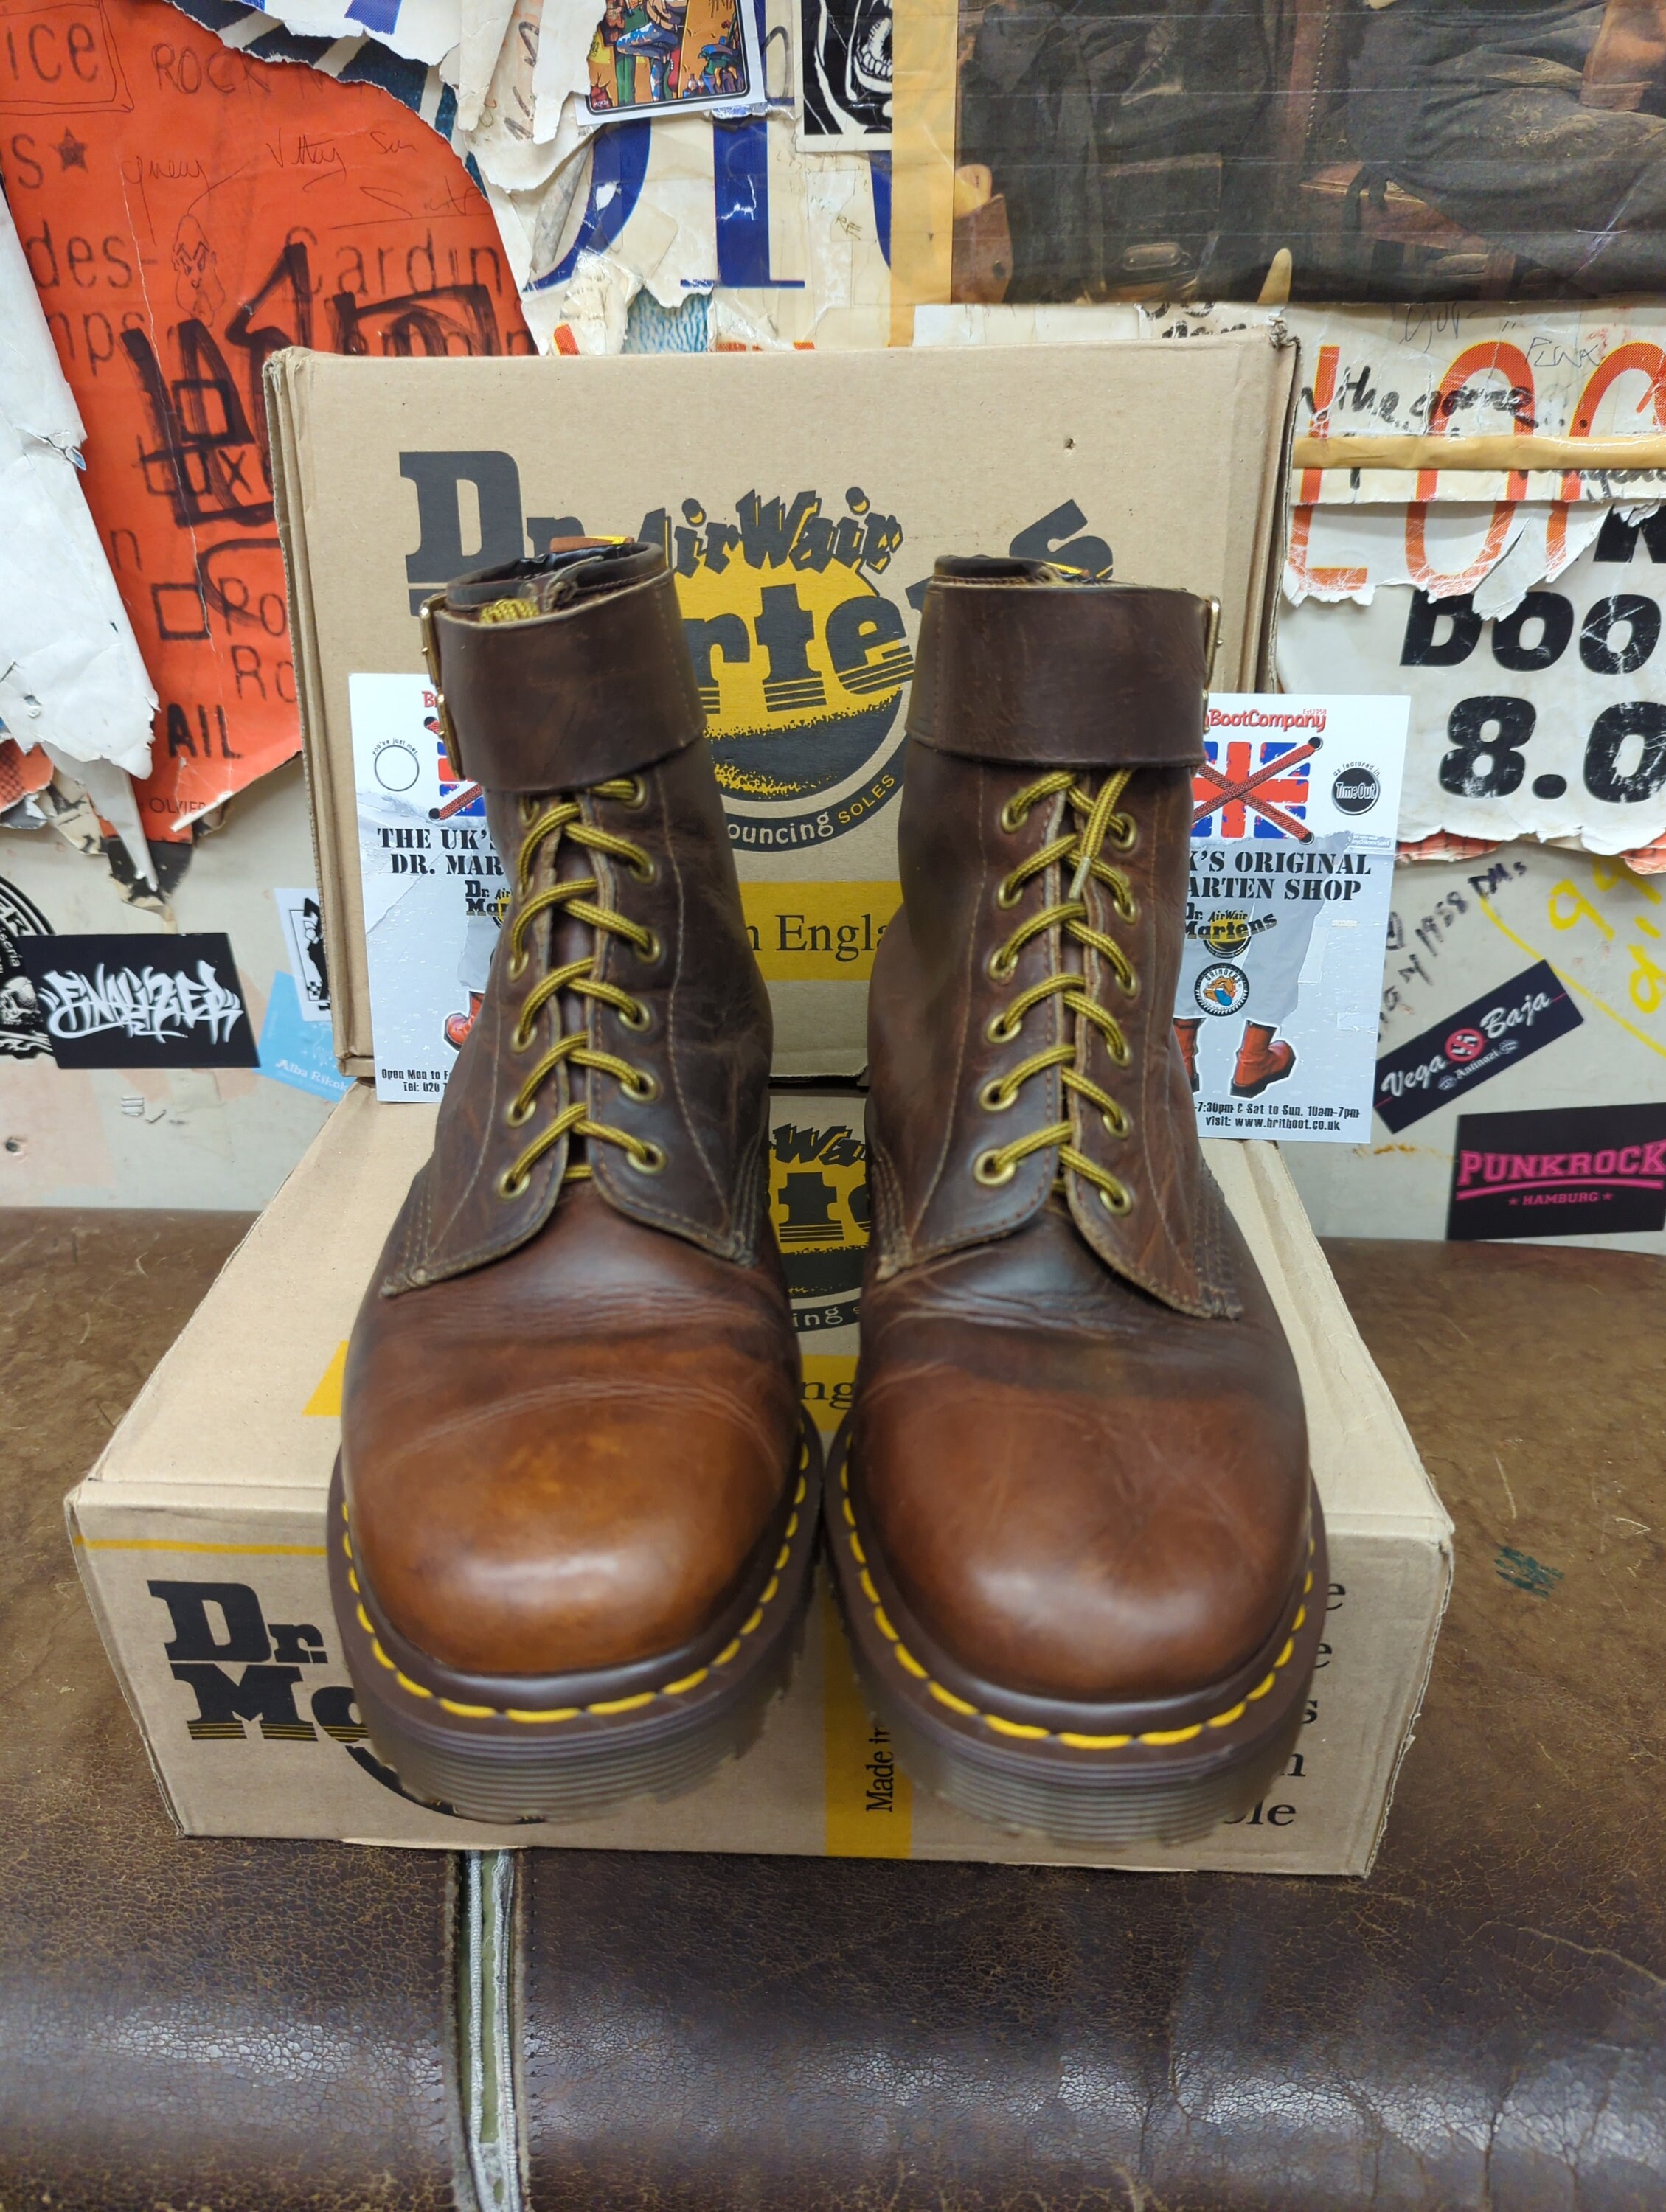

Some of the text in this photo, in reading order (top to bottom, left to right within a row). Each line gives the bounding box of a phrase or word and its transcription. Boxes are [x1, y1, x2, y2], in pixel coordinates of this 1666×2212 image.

[838, 774, 895, 824] SOLES
[378, 828, 431, 849] THE
[391, 854, 435, 874] DR.
[1235, 852, 1372, 875] ORIGINAL
[465, 880, 490, 897] Dr.
[494, 888, 513, 900] Air
[1284, 880, 1361, 901] SHOP
[1185, 913, 1277, 939] Martens
[1207, 910, 1248, 922] AirWair
[1204, 968, 1242, 984] GRINDERS
[1381, 992, 1551, 1097] Vega Baja
[381, 1069, 404, 1080] Open
[407, 1070, 427, 1079] Mon
[430, 1070, 441, 1080] to
[403, 1082, 420, 1092] Tel:
[423, 1082, 440, 1093] 020
[1246, 1103, 1264, 1114] Sat
[1268, 1105, 1278, 1115] to
[1308, 1106, 1360, 1119] 10am-7pm
[1235, 1118, 1341, 1131] www.britboot.co.uk
[1457, 1138, 1666, 1186] PUNKROCK
[1522, 1192, 1599, 1206] HAMBURG
[147, 1580, 328, 1664] Dr.
[864, 1750, 895, 1813] Made
